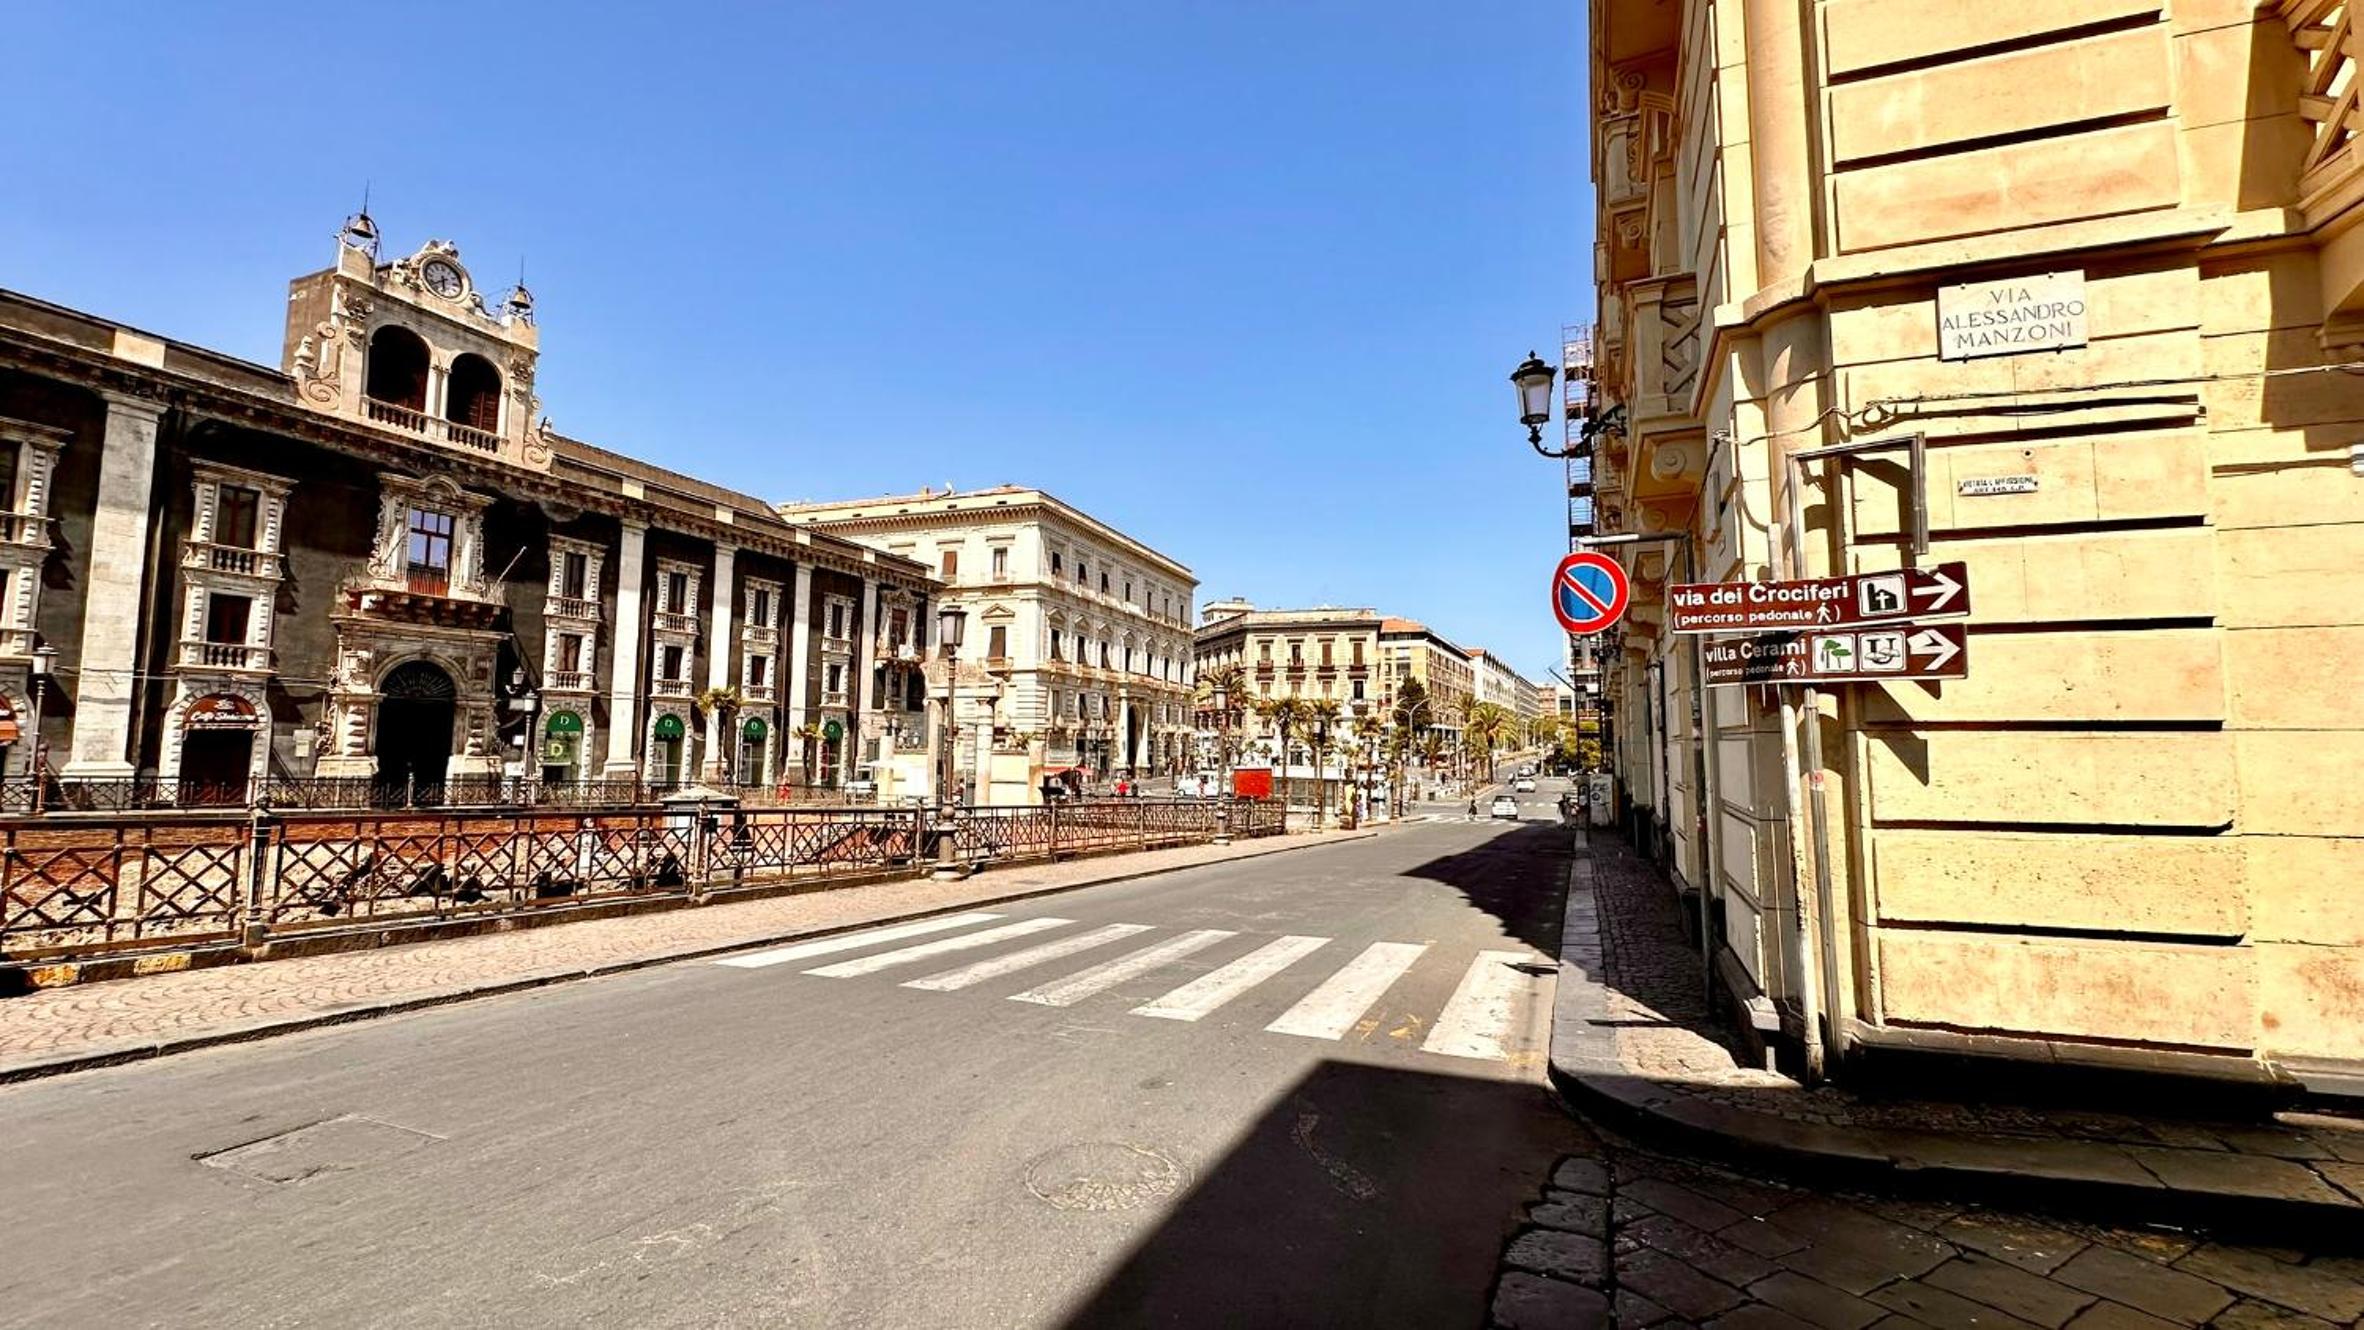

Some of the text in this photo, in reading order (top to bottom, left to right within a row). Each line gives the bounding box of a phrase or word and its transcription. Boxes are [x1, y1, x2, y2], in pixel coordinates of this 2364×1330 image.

[1990, 288, 2032, 304] VIA
[1943, 300, 2085, 331] ALESSANDRO
[1957, 321, 2072, 349] MANZONI
[1673, 581, 1849, 607] via dei Crociferi
[1748, 609, 1813, 625] pedonale
[1705, 638, 1807, 663] villa Cerami
